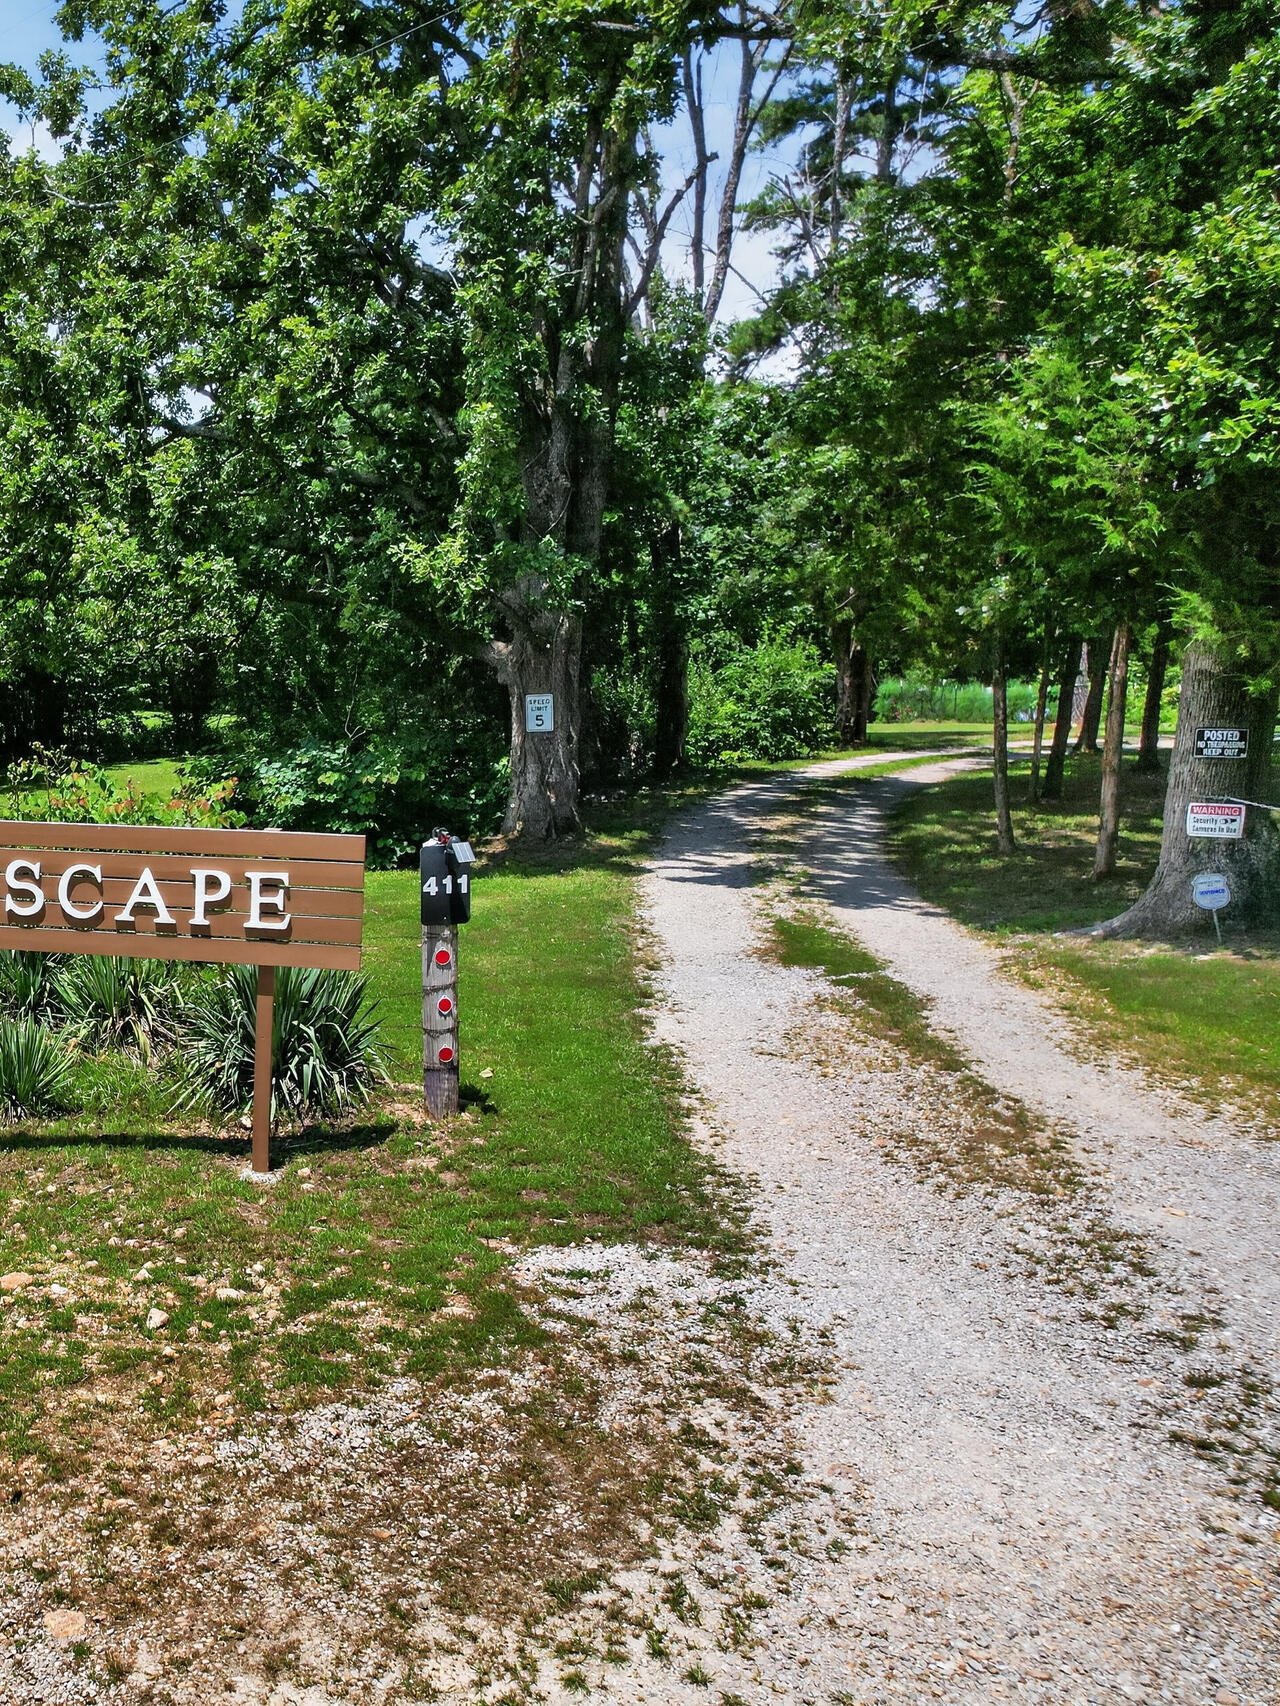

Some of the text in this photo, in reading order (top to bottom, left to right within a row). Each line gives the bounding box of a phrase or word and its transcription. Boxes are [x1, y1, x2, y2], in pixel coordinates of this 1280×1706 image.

[536, 715, 544, 726] 5
[1204, 730, 1240, 740] POSTED
[1192, 806, 1240, 815] WARNING
[1193, 817, 1218, 825] Security
[423, 874, 468, 895] 411
